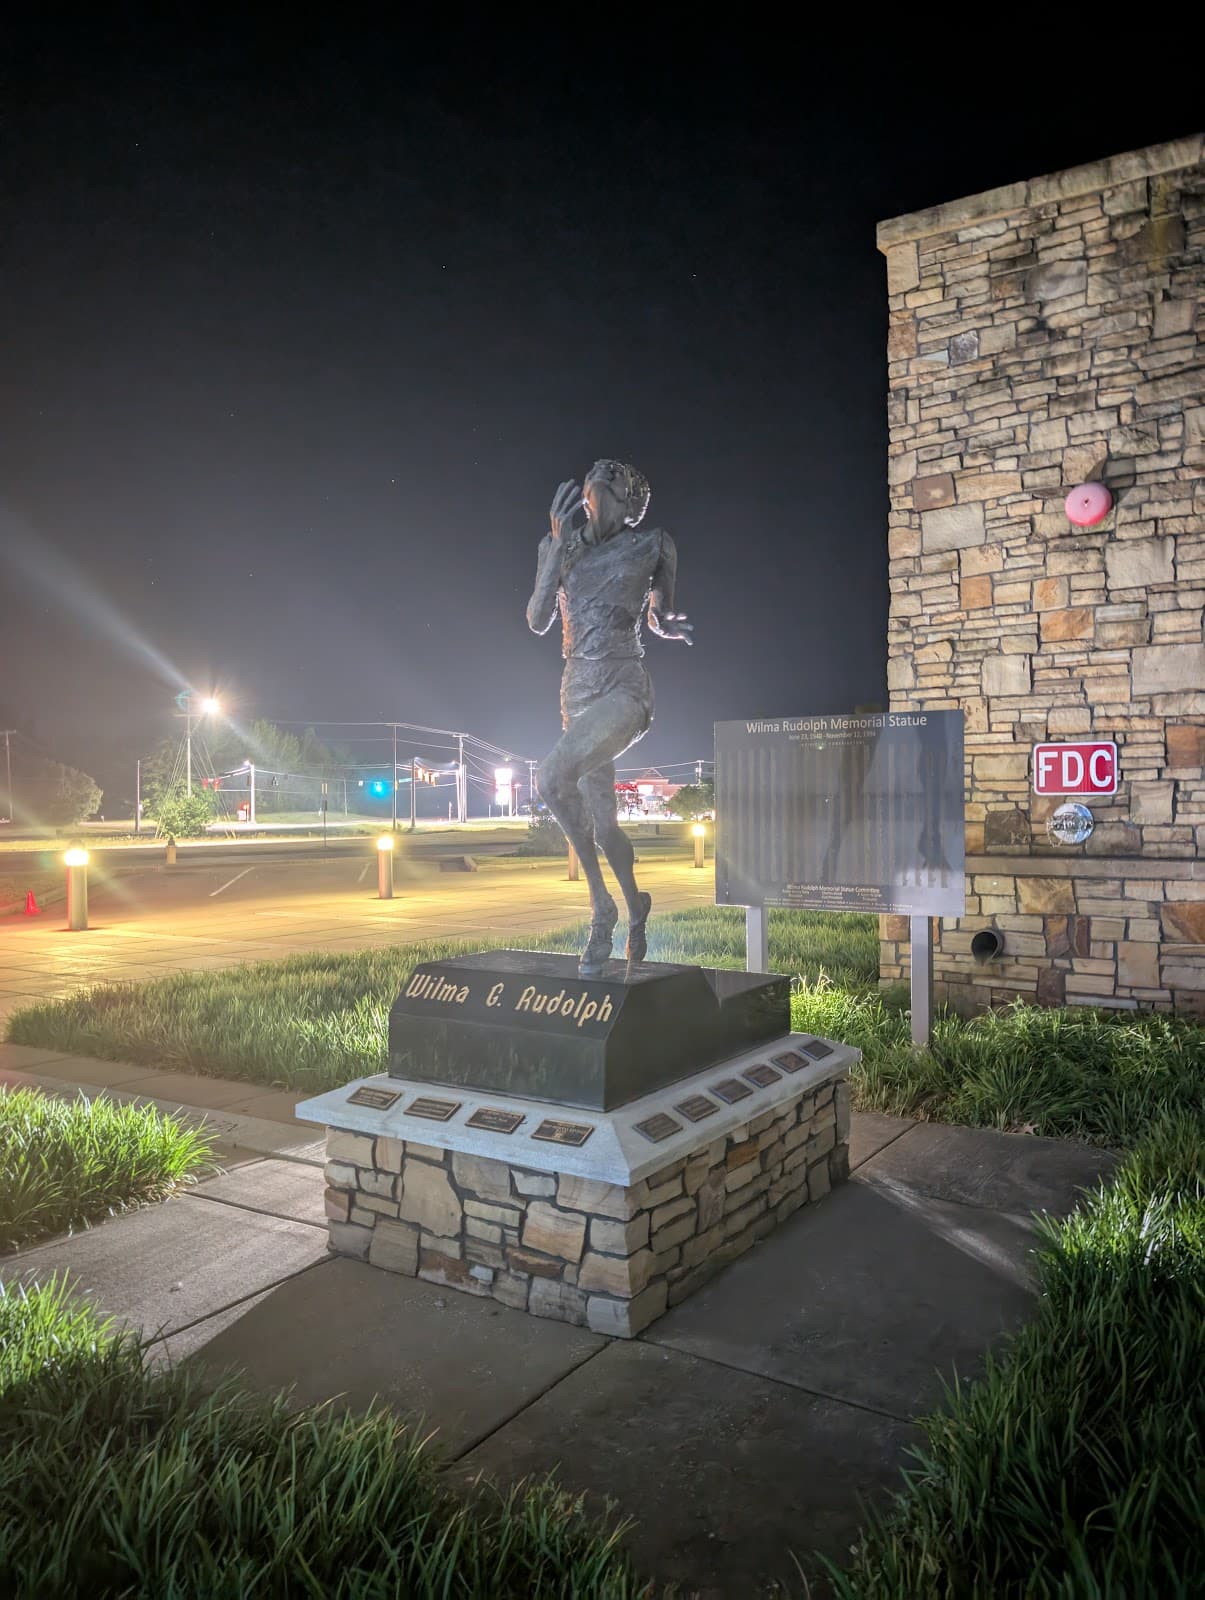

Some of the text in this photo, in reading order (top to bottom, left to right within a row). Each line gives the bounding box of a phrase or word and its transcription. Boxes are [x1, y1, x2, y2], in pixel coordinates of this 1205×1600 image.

[746, 714, 928, 734] Wilma Rudolph Memorial Statue
[1038, 749, 1112, 788] FDC
[405, 973, 613, 1027] Wilma G. Rudolph
